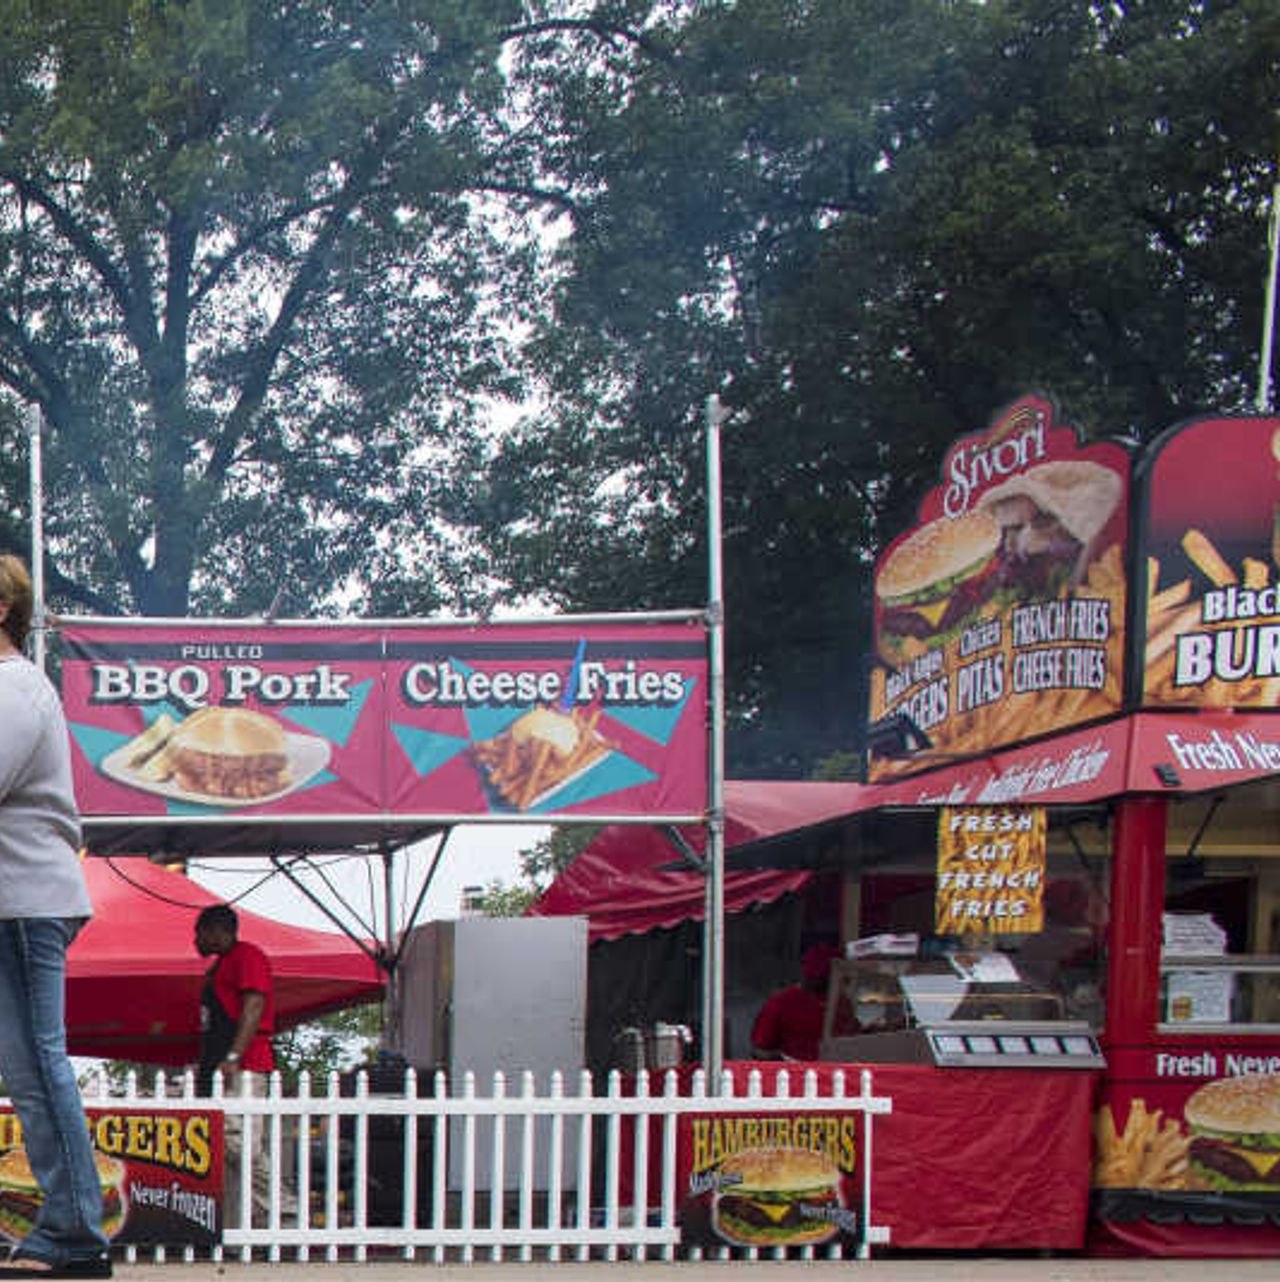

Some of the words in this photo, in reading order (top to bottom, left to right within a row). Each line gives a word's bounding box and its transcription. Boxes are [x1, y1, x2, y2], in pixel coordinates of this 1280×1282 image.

[944, 411, 1045, 520] Sivori
[1203, 586, 1280, 622] Blac
[182, 646, 262, 660] PULLED
[1176, 626, 1280, 686] BUR
[95, 666, 208, 705] BBQ
[225, 666, 351, 701] Pork
[405, 664, 560, 701] Cheese
[576, 663, 685, 701] Fries
[949, 814, 1034, 832] FRESH
[965, 844, 1014, 861] CUT
[939, 870, 1041, 890] FRENCH
[950, 898, 1028, 917] FRIES
[1157, 1053, 1216, 1076] Fresh
[1225, 1054, 1280, 1076] Neve
